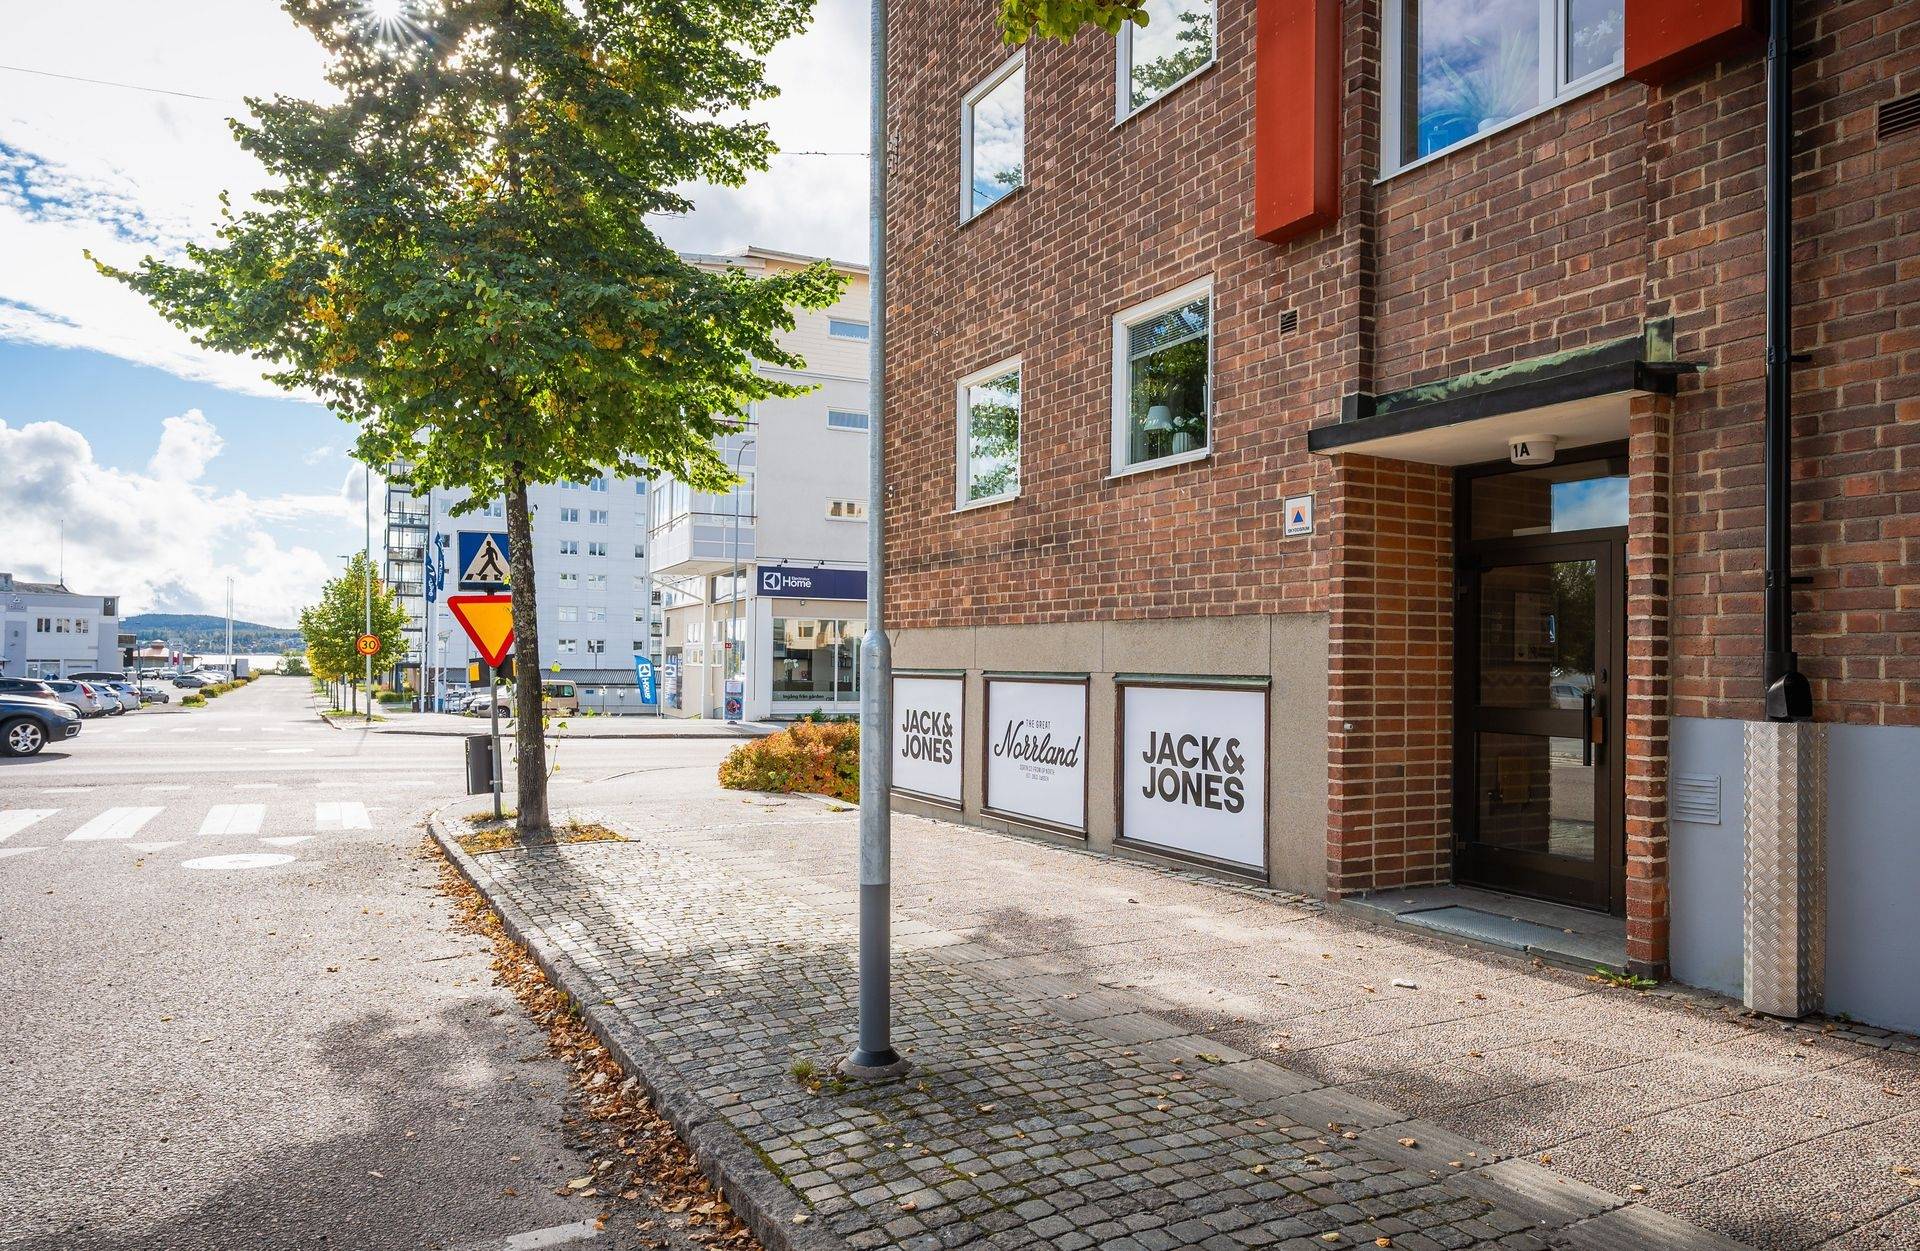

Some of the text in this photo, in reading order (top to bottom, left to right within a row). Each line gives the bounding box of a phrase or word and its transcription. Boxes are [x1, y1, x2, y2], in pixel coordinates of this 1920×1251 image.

[1513, 442, 1530, 458] 1A
[782, 576, 812, 588] Home
[362, 640, 377, 649] 30
[1026, 719, 1051, 730] THE GREAT
[901, 734, 953, 765] JONES
[994, 720, 1081, 768] Norrland
[1142, 766, 1245, 814] JONES
